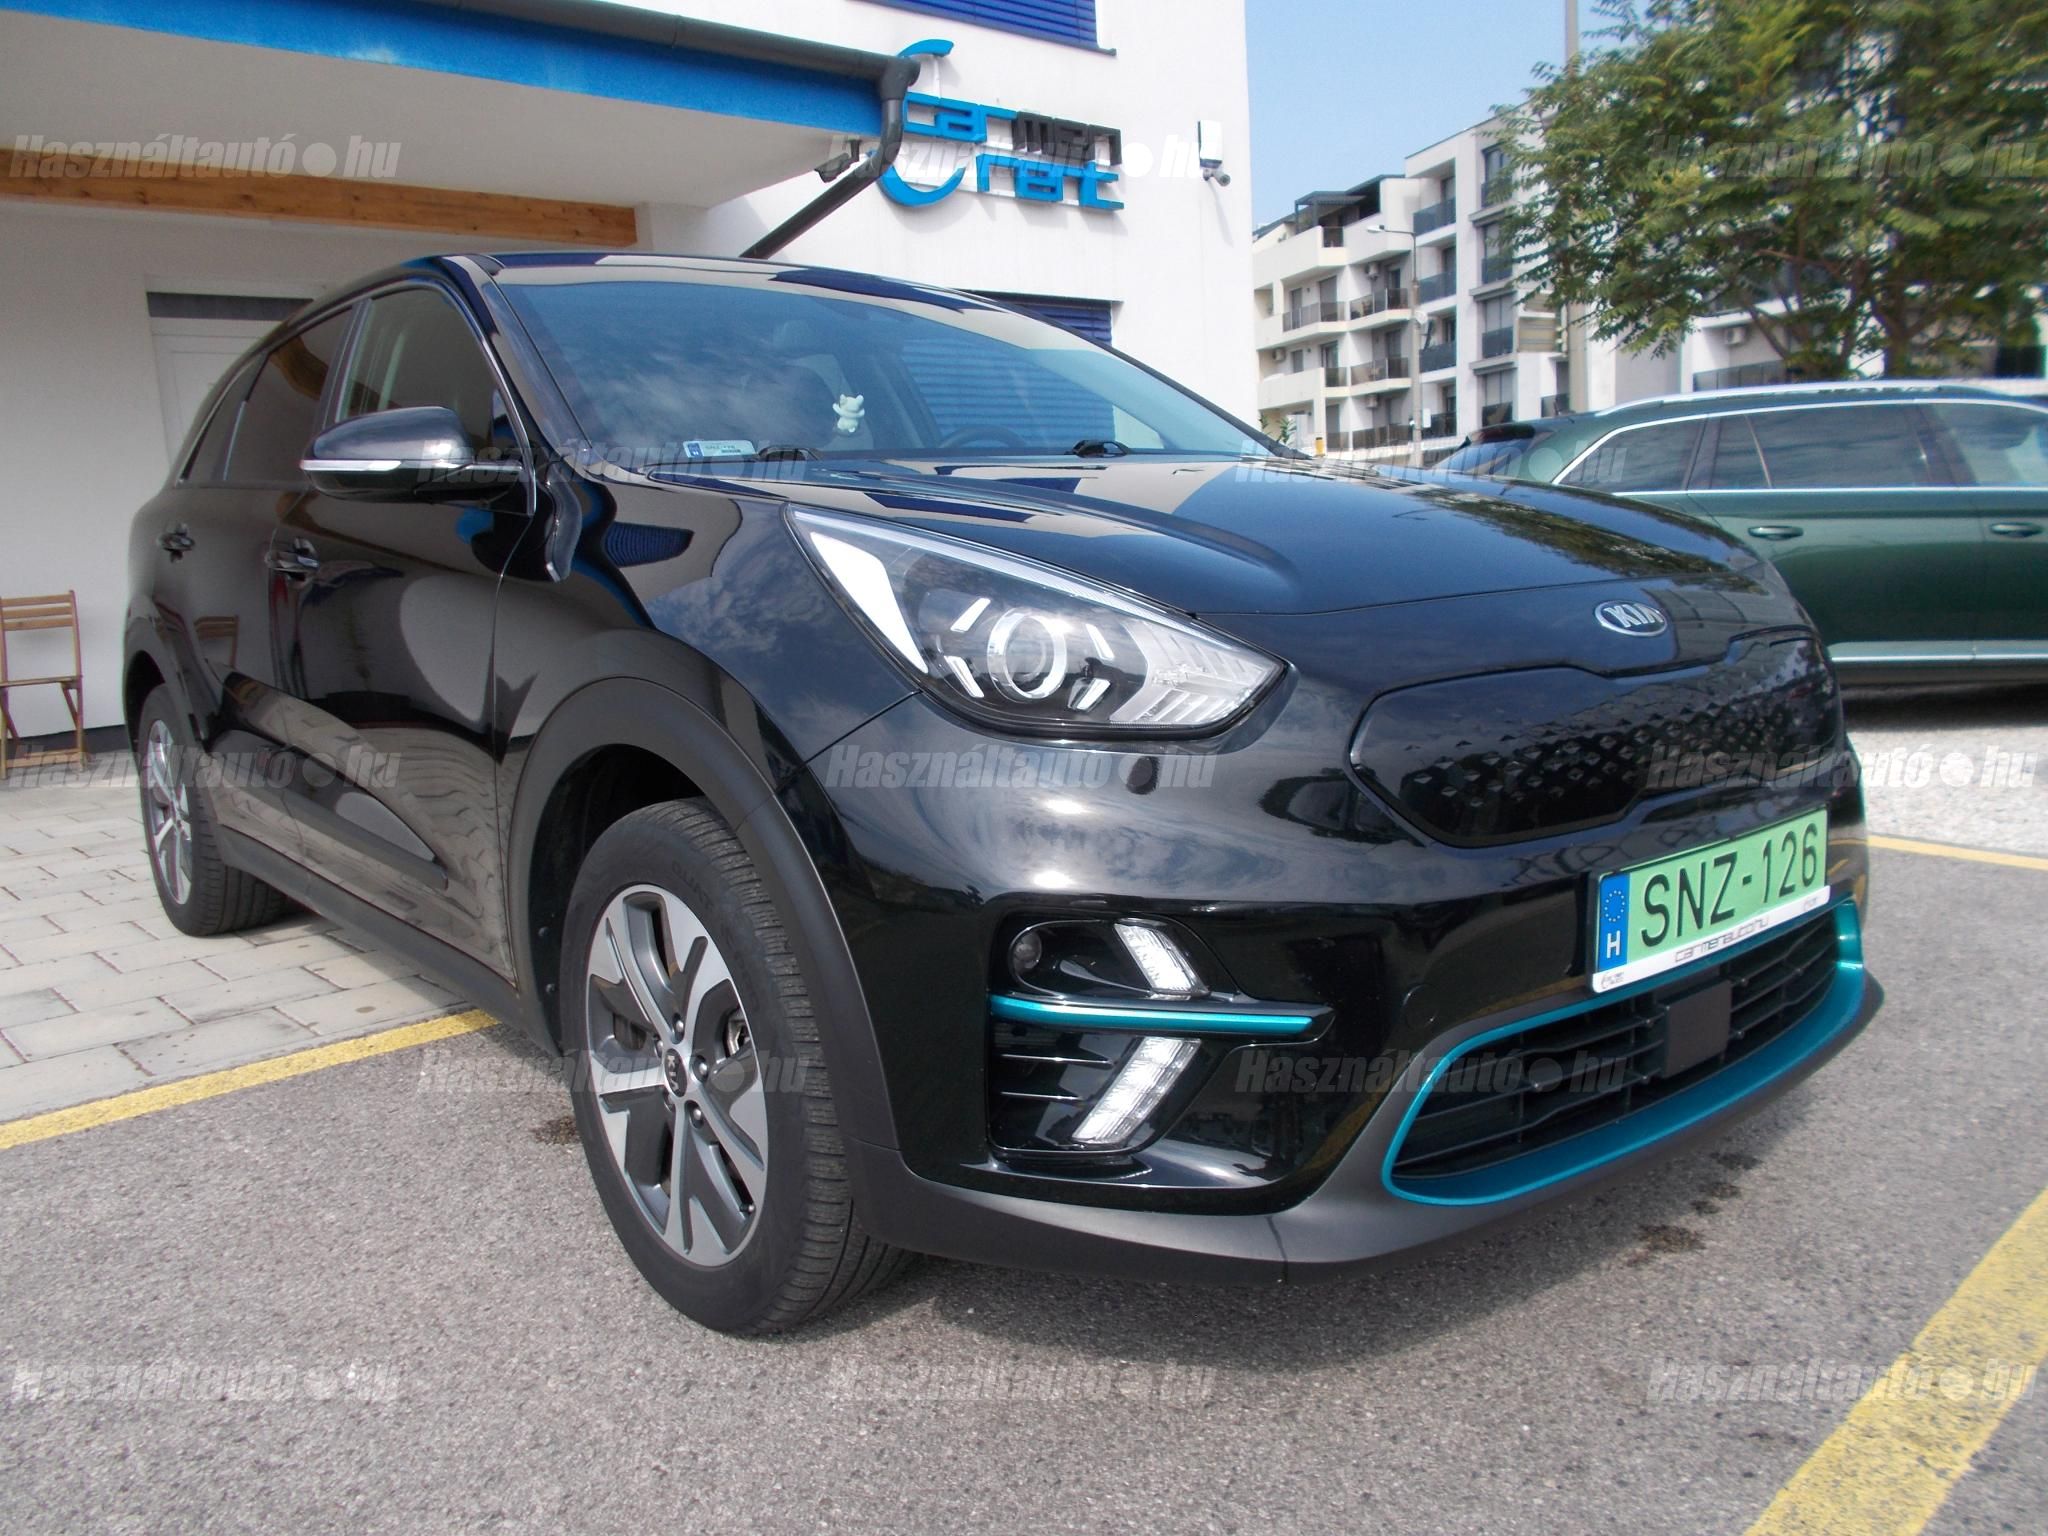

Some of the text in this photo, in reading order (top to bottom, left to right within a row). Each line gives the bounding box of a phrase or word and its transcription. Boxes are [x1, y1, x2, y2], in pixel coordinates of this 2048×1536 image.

[1602, 603, 1664, 628] KIA
[1640, 822, 1819, 947] SNZ-126
[1606, 930, 1621, 959] H
[667, 1055, 681, 1092] KIA
